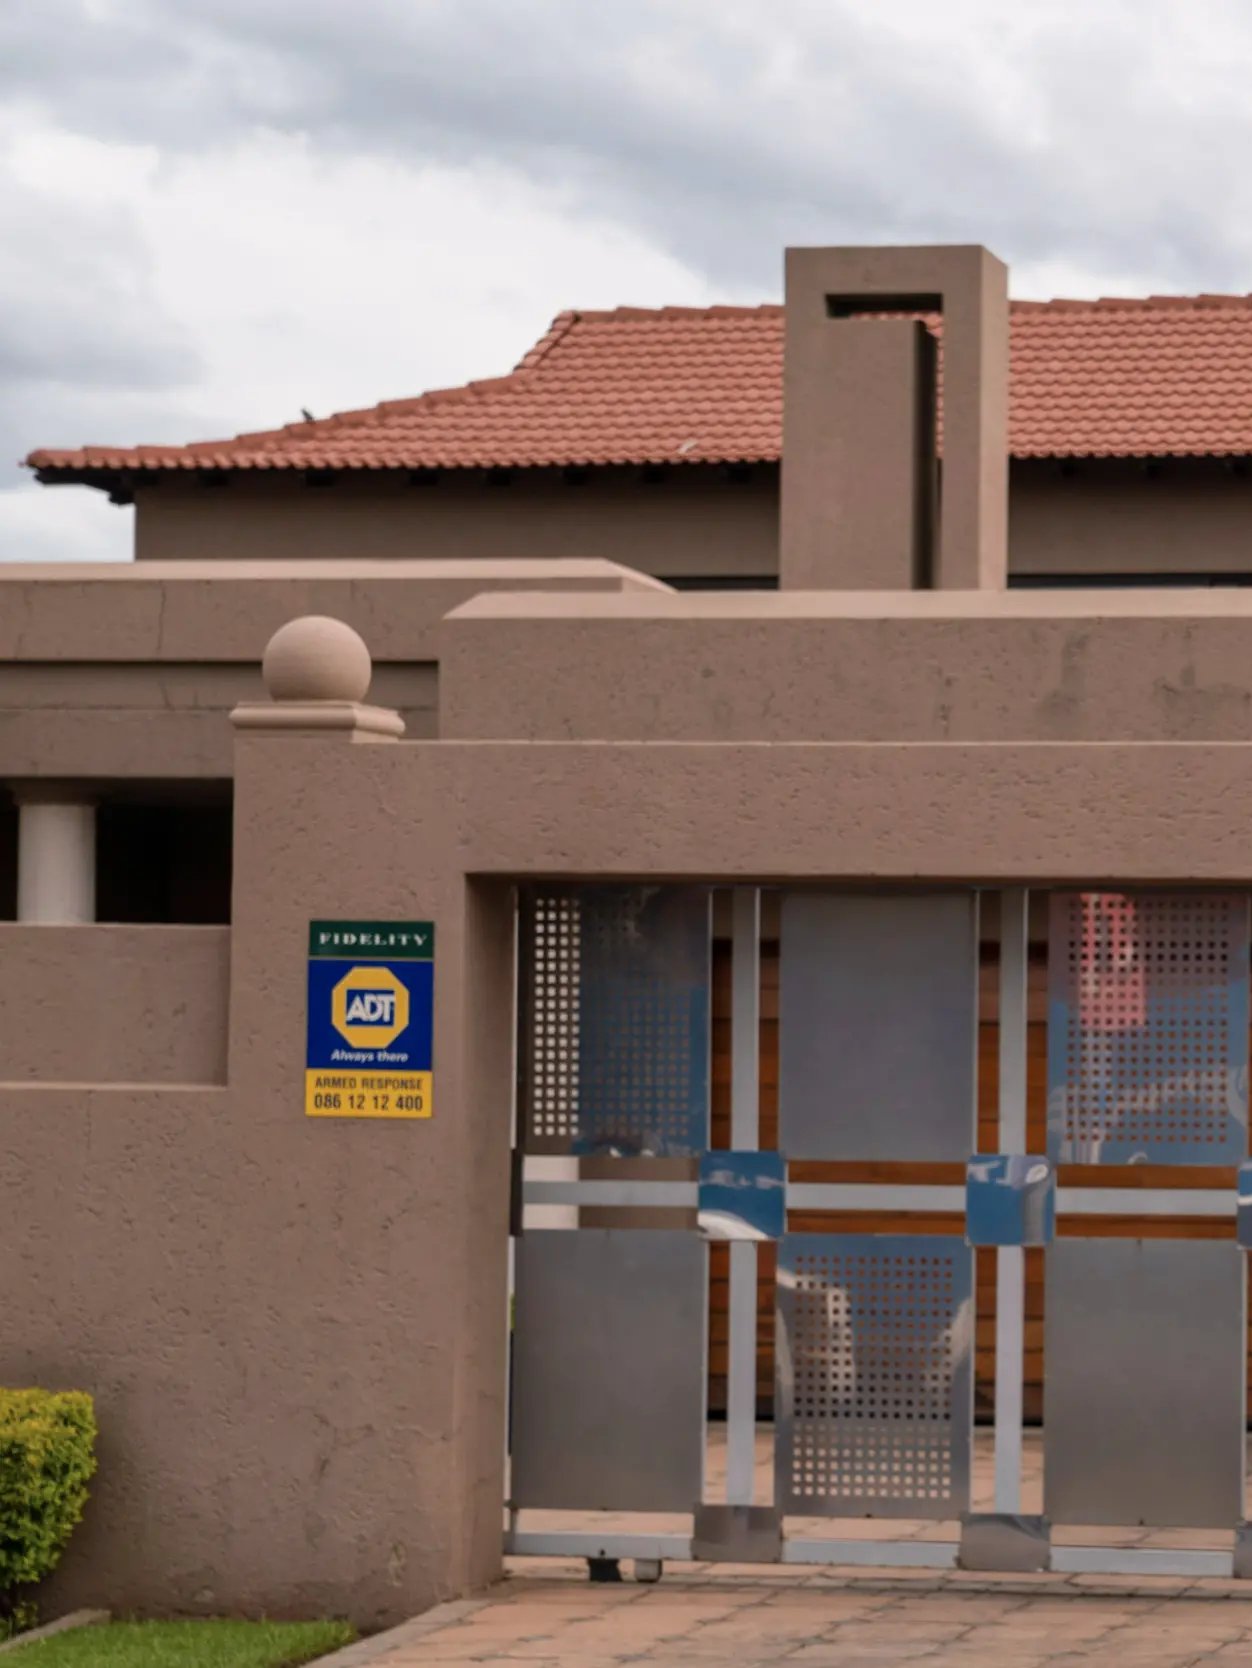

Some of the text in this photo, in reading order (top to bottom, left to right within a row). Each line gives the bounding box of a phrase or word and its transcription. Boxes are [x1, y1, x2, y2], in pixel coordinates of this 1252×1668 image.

[319, 932, 427, 946] FIDELITY
[345, 993, 396, 1022] ADT
[331, 1049, 409, 1063] Always there
[315, 1076, 424, 1090] ARMED RESPONSE
[314, 1094, 423, 1111] 086 12 12 400
